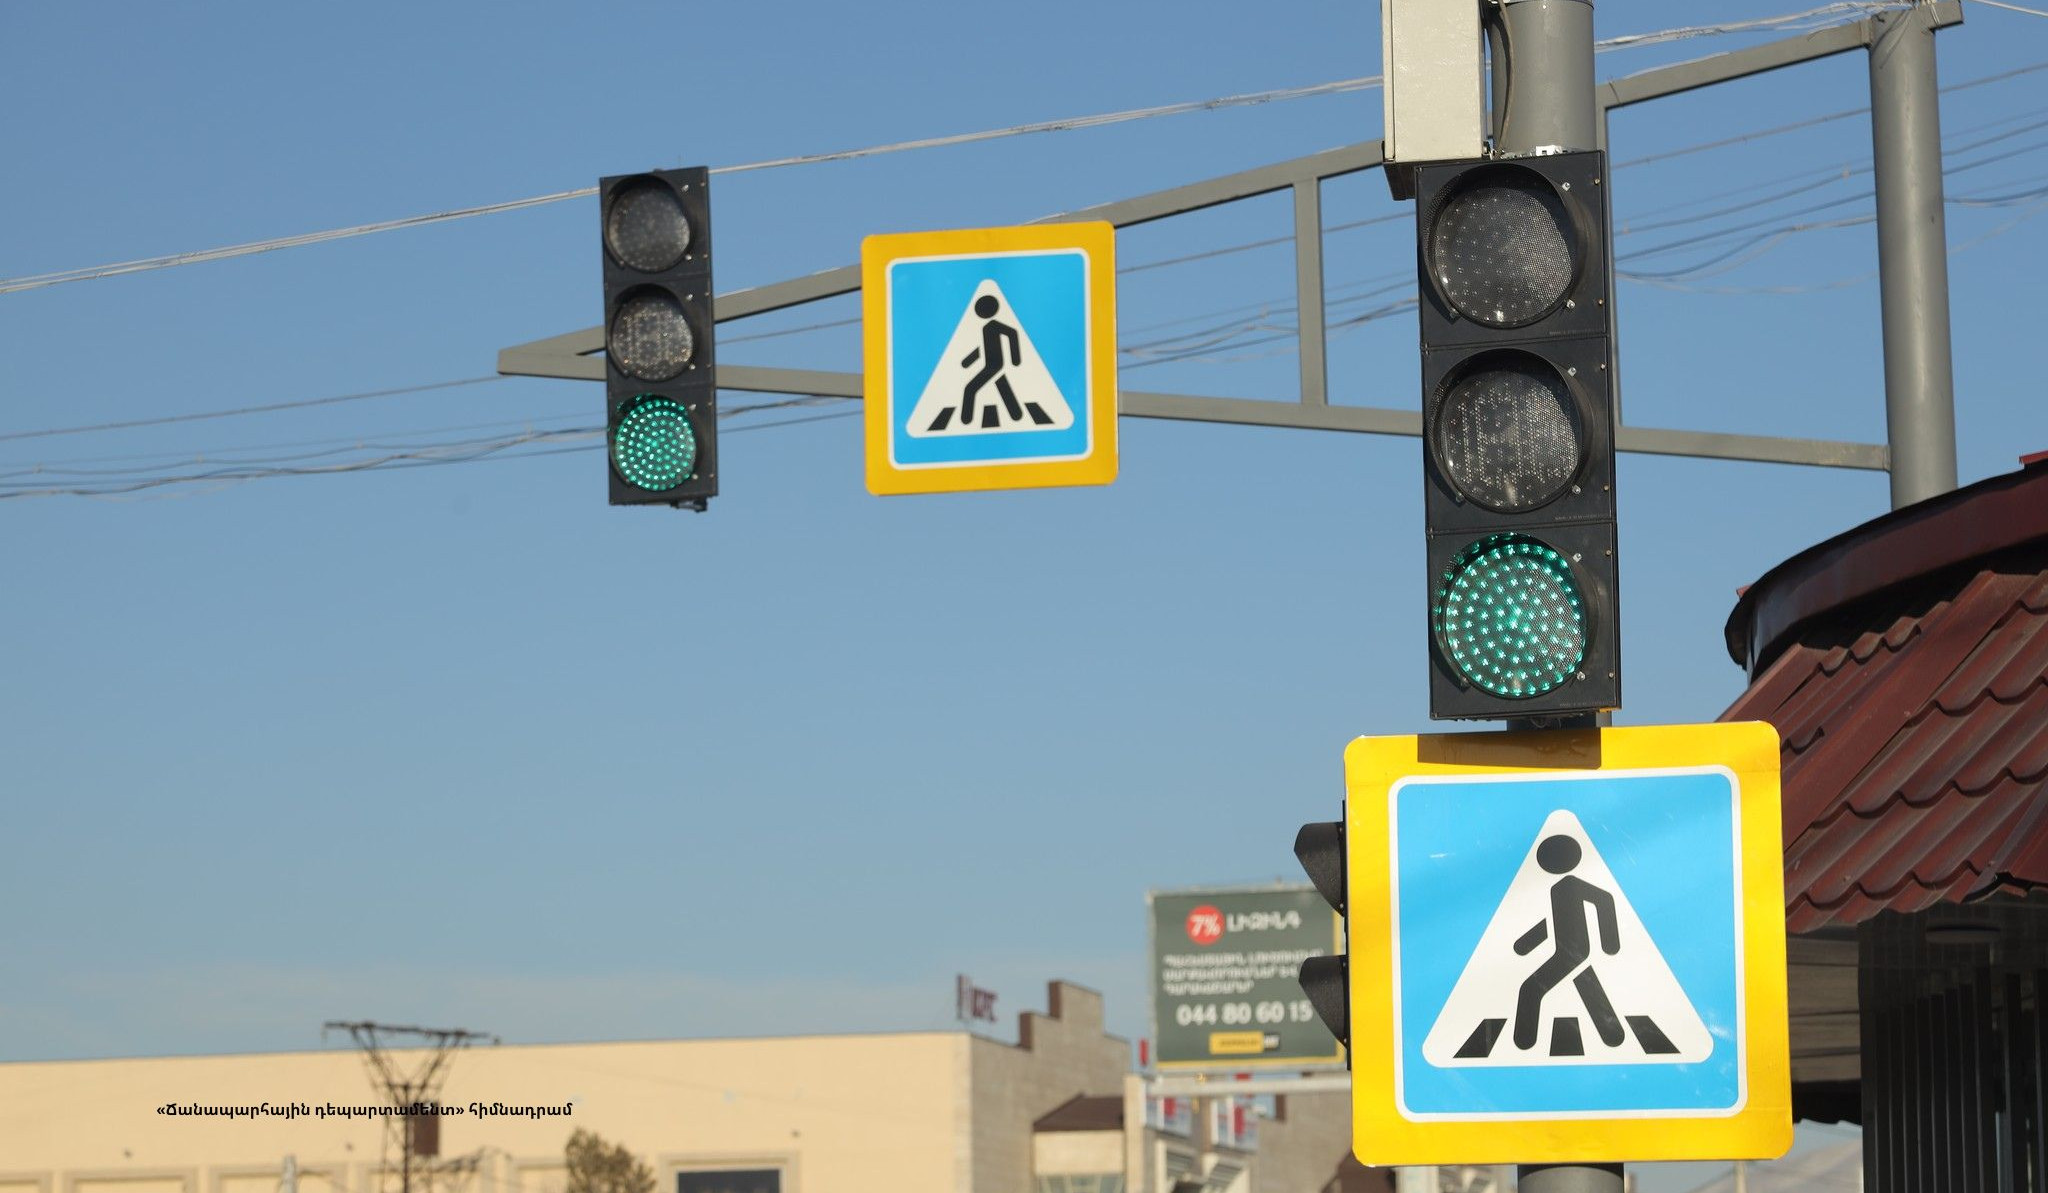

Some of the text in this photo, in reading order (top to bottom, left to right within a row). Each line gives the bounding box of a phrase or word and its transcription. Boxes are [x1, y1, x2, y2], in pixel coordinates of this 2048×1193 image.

[1189, 913, 1221, 937] 7%
[1176, 1004, 1217, 1026] 044
[1221, 1002, 1252, 1025] 80
[1255, 1001, 1285, 1023] 60
